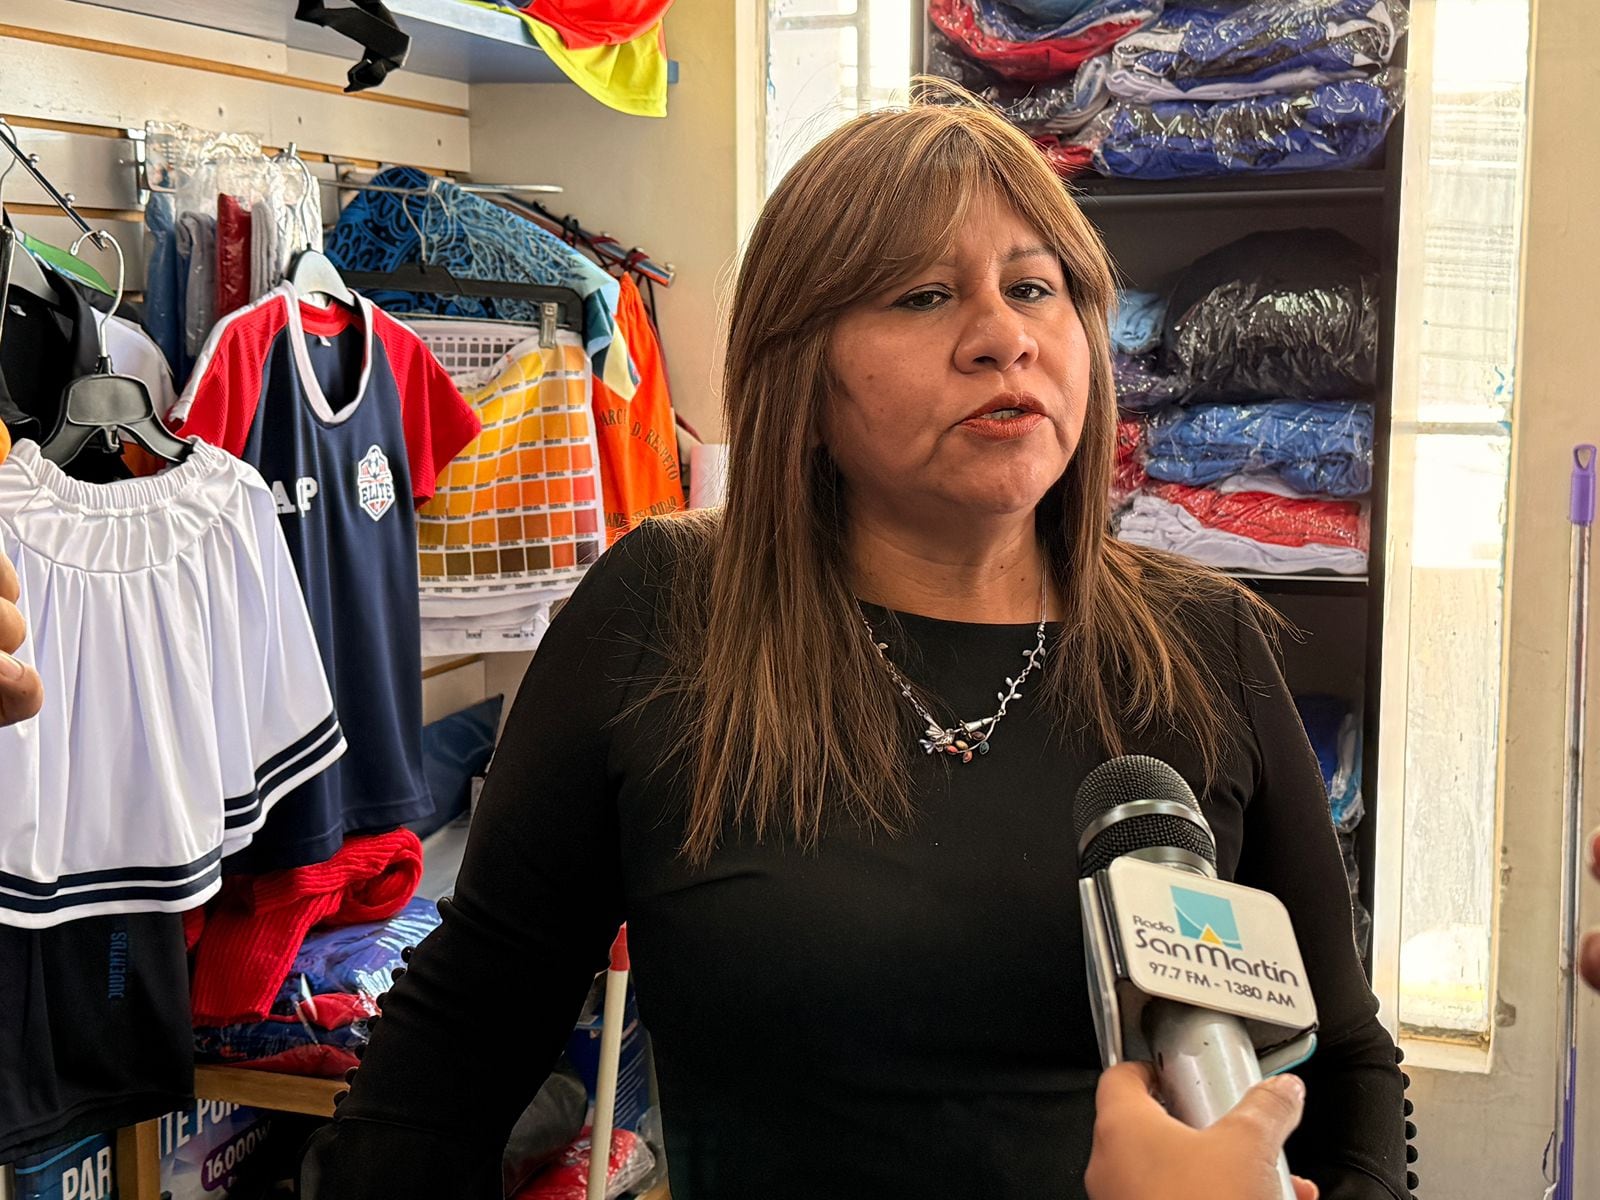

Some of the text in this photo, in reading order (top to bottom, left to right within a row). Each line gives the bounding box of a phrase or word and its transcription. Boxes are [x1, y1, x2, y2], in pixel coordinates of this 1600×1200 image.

[361, 483, 392, 504] ELITE
[1132, 914, 1175, 934] Radio
[108, 931, 128, 999] JUVENTUS
[1149, 961, 1182, 980] 97.7
[1185, 970, 1211, 989] FM
[1224, 979, 1263, 1000] 1380
[1266, 990, 1296, 1009] AM
